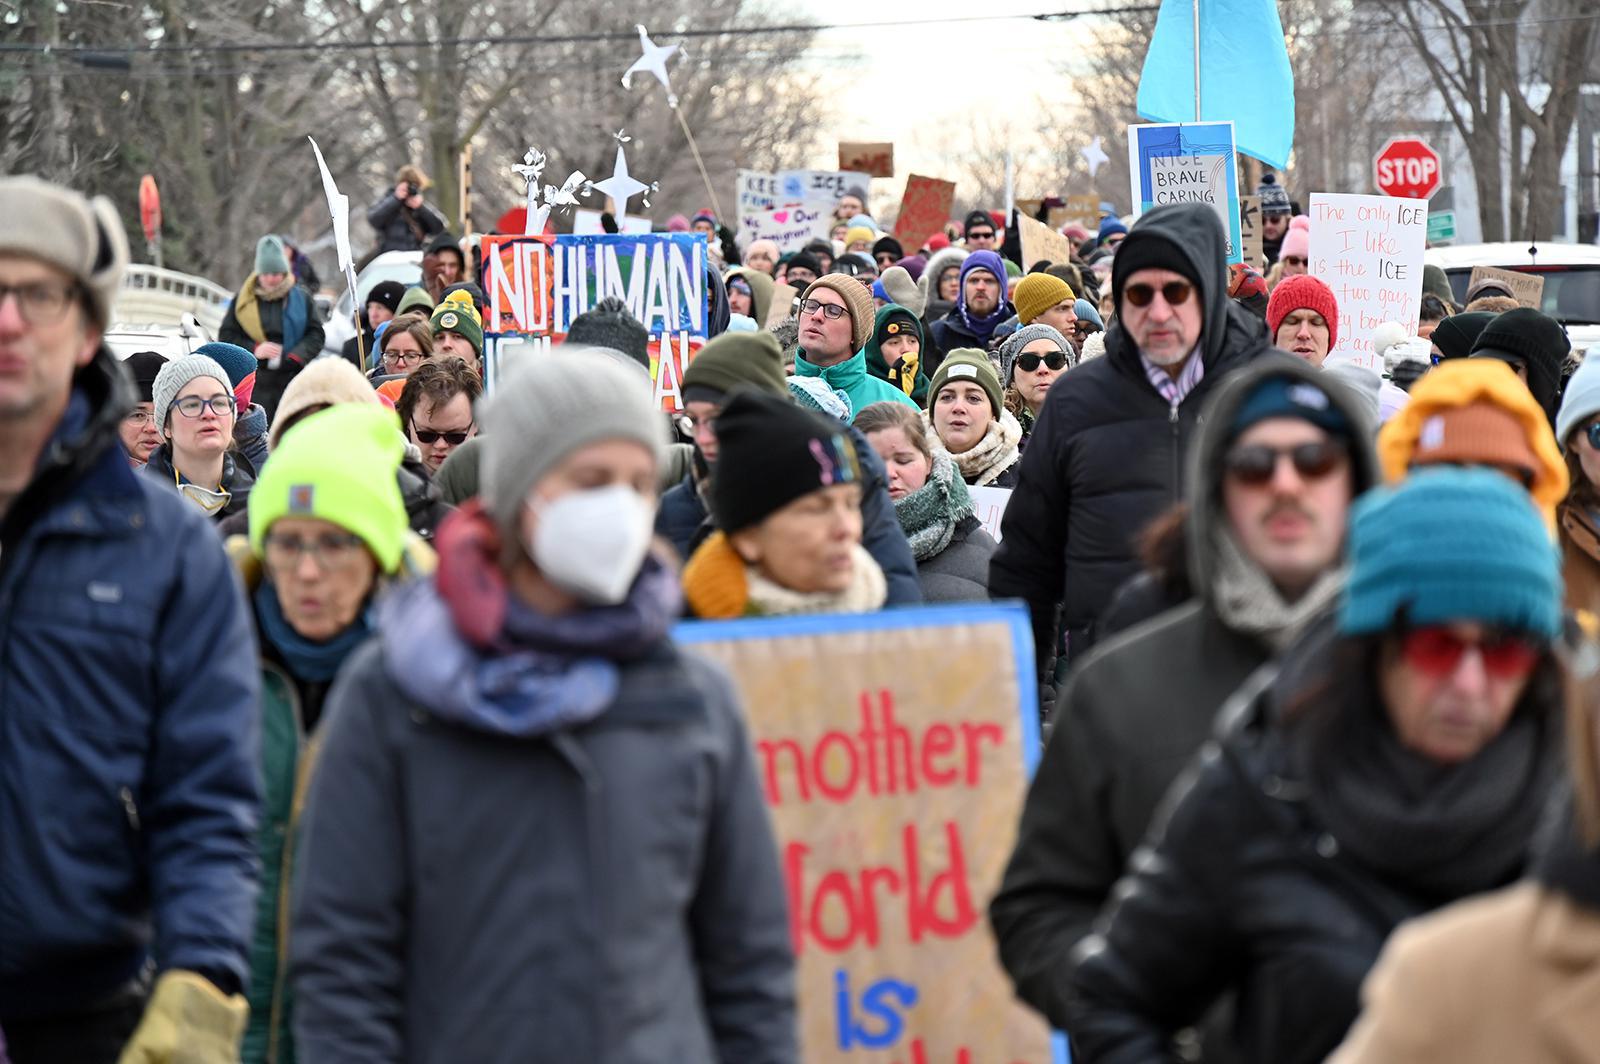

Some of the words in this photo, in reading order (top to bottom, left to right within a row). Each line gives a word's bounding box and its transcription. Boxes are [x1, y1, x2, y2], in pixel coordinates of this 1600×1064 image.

[1153, 149, 1203, 168] NICE
[1378, 157, 1436, 187] STOP
[1156, 170, 1208, 187] BRAVE
[1157, 189, 1215, 205] CARING
[1312, 203, 1345, 221] The
[1357, 205, 1391, 233] only
[1397, 204, 1424, 226] ICE
[1336, 230, 1357, 254] I
[1365, 230, 1402, 256] like
[1312, 257, 1327, 275] is
[1333, 259, 1367, 277] the
[1379, 258, 1407, 280] ICE
[489, 242, 548, 333] NO
[553, 241, 702, 334] HUMAN
[1336, 283, 1371, 304] two
[1379, 287, 1412, 316] gay
[756, 687, 1006, 806] nother
[834, 968, 919, 1051] is
